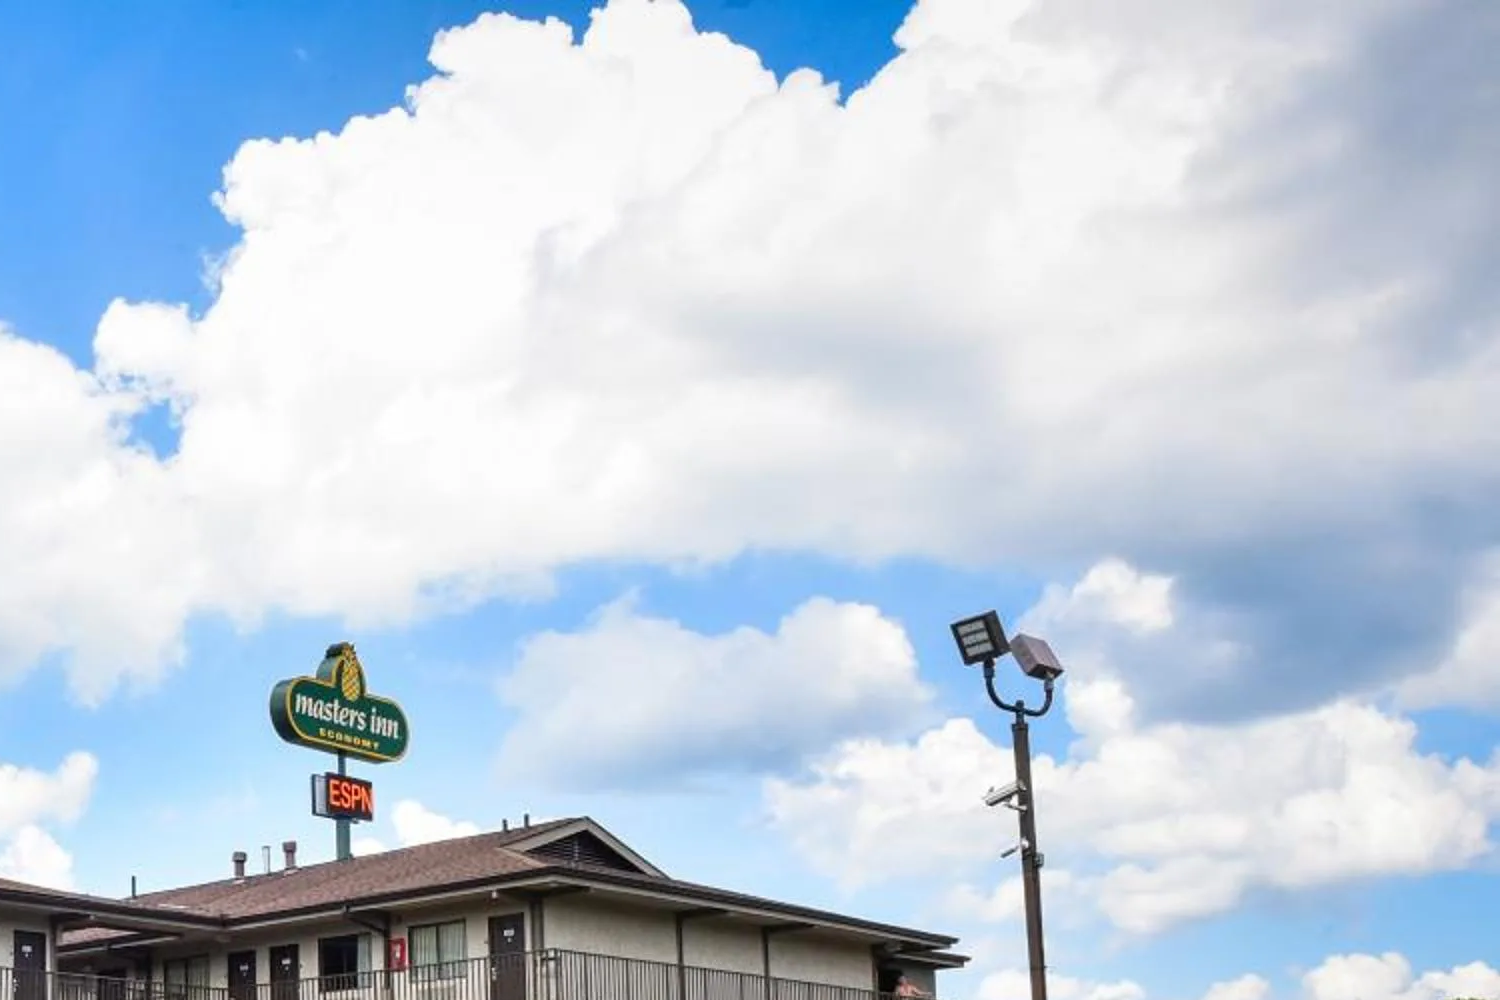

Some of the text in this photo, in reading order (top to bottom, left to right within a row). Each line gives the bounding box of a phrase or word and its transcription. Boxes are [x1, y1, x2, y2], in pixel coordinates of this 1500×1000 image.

[295, 694, 399, 739] masters inn
[319, 727, 380, 750] ECONOMY
[329, 779, 373, 814] ESPN
